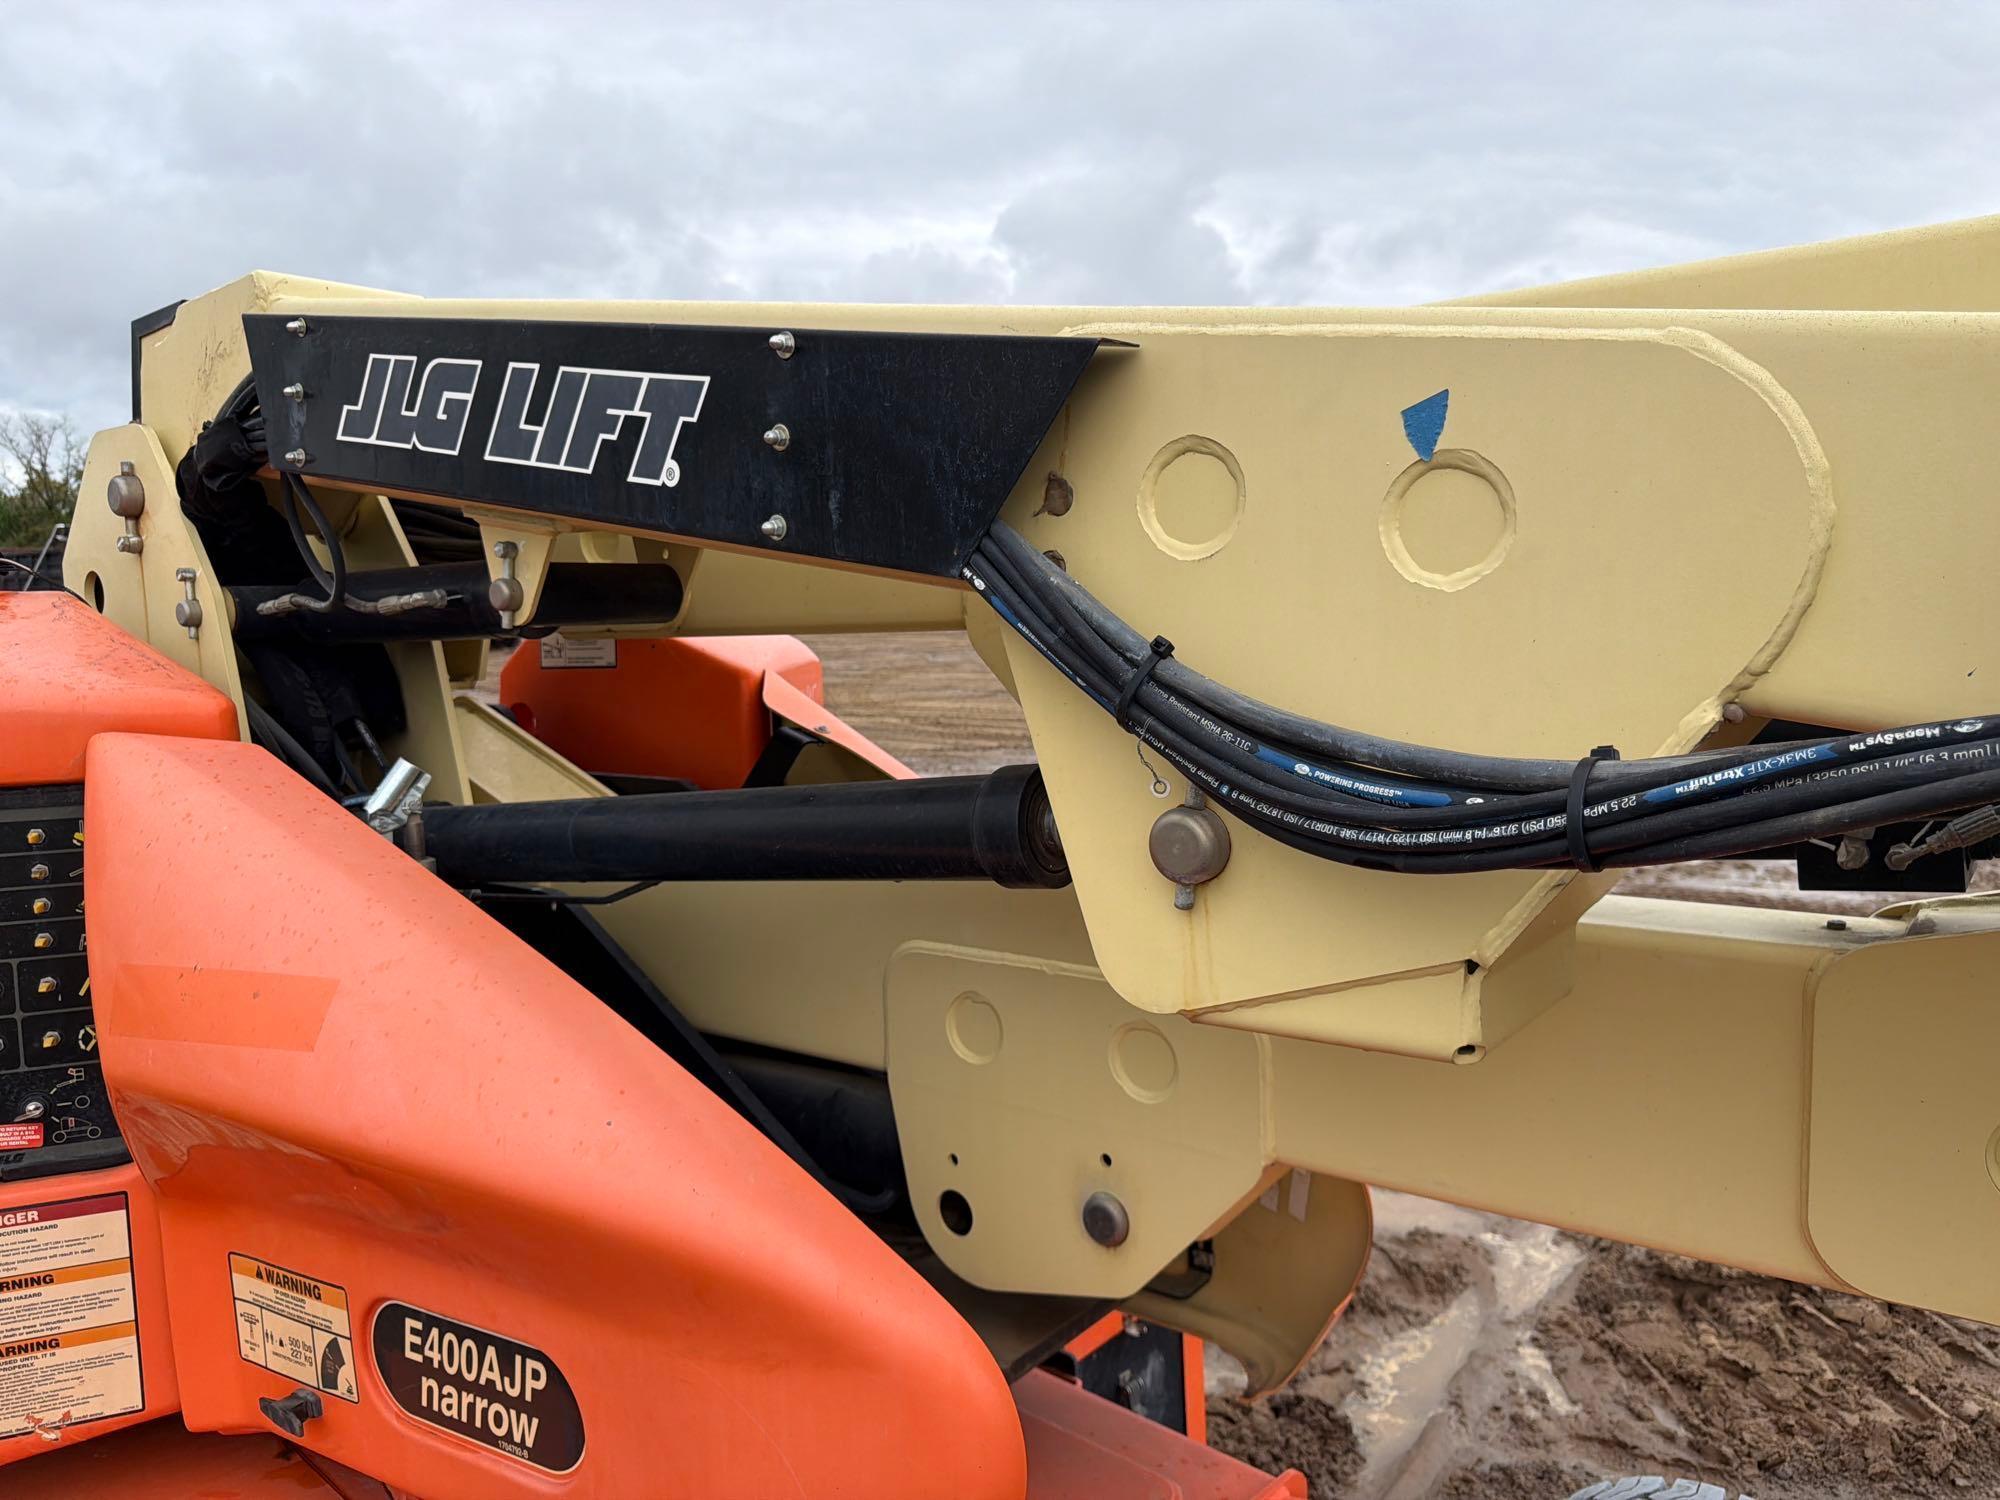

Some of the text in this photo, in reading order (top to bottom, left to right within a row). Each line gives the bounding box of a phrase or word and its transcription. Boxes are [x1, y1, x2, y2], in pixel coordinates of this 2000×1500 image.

[336, 353, 482, 456] JLG
[1169, 696, 1201, 723] Resistant
[1200, 717, 1222, 735] MSHA
[1221, 730, 1252, 751] 2G-11C
[1313, 770, 1352, 790] POWERING
[1256, 801, 1283, 820] 18752
[1584, 802, 1609, 817] MPa
[1611, 795, 1637, 812] 22.5
[1282, 811, 1298, 824] ISO
[1304, 819, 1338, 835] 100R17
[30, 1224, 58, 1232] HAZARD
[264, 1267, 322, 1301] WARNING
[14, 1291, 42, 1301] HAZARD
[288, 1336, 301, 1349] 500
[291, 1347, 314, 1367] 227 kg
[405, 1317, 547, 1402] E400AJP
[421, 1376, 539, 1448] narrow
